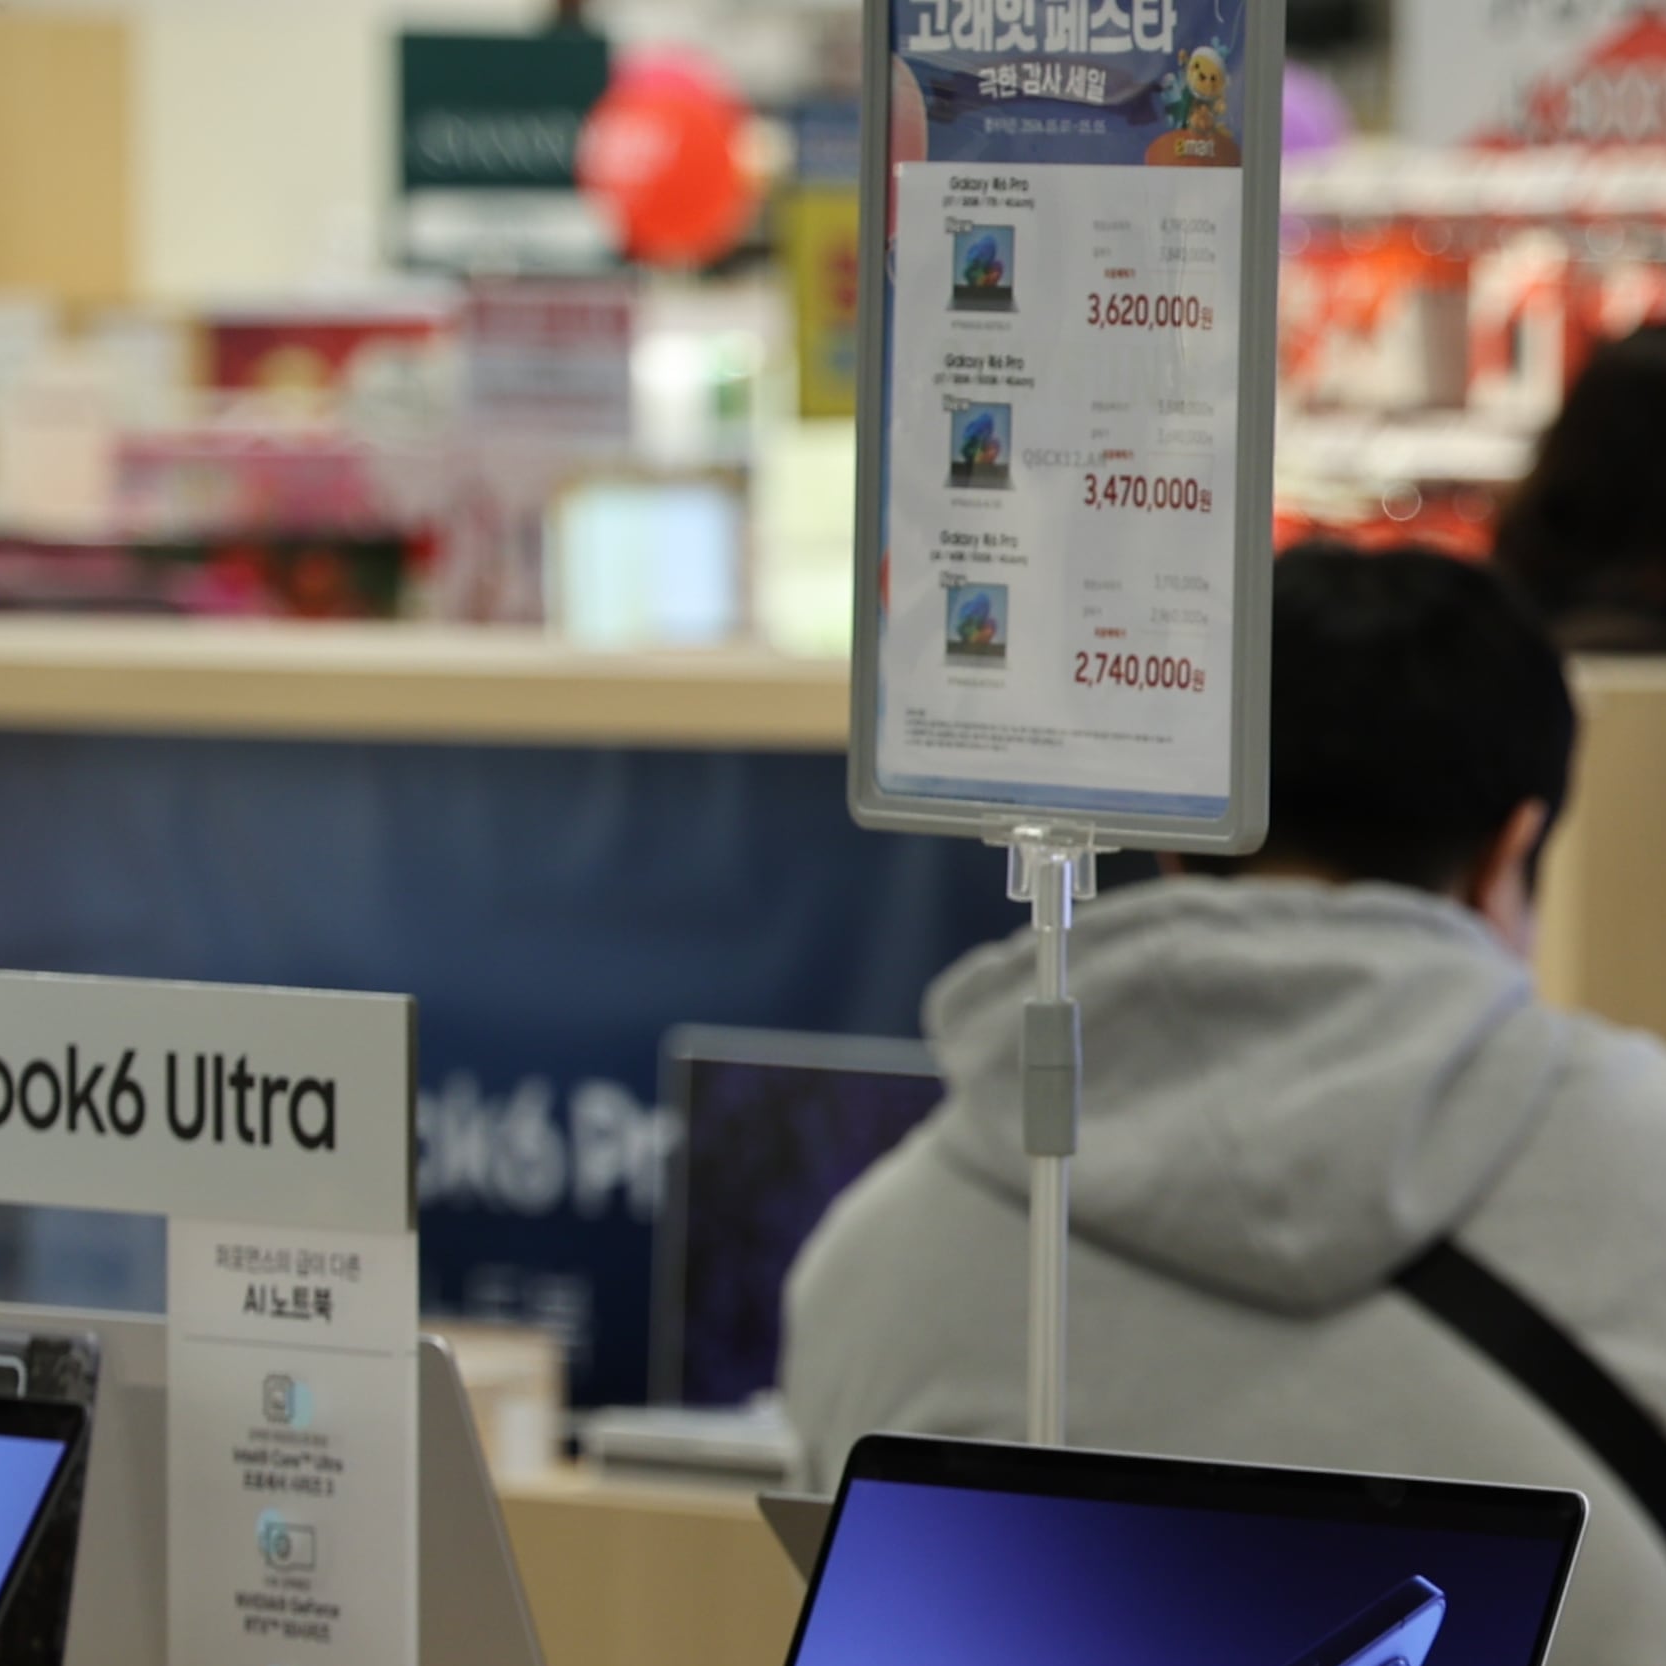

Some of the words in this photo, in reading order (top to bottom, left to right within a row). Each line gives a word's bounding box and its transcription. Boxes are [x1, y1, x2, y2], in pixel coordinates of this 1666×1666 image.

[907, 0, 1037, 53] 고래잇
[1044, 0, 1177, 54] 페스타
[978, 66, 1017, 100] 극한
[1022, 62, 1063, 95] 감사
[1065, 63, 1107, 102] 세일
[1086, 292, 1214, 330] 3,620,000원
[1084, 474, 1212, 513] 3,470,000원
[1074, 651, 1205, 692] 2,740,000원
[164, 1049, 338, 1152] Ultra
